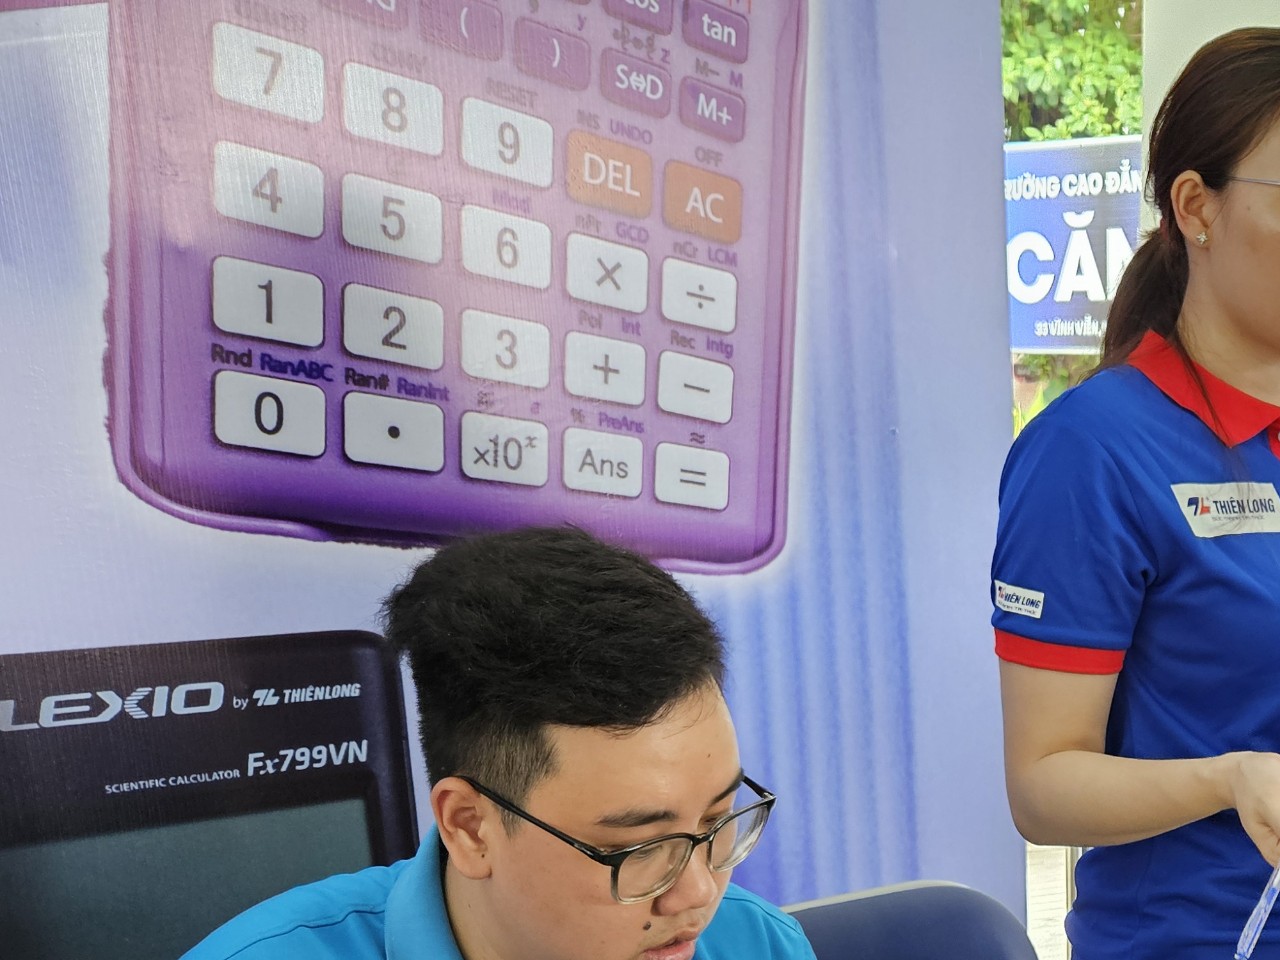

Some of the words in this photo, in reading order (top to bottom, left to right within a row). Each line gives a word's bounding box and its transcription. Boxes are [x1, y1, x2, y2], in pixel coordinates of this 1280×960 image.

[701, 13, 738, 47] tan
[255, 47, 283, 95] 7
[381, 86, 408, 133] 8
[696, 93, 733, 126] M+
[498, 121, 520, 165] 9
[609, 118, 654, 145] UNDO
[583, 151, 641, 197] DEL
[695, 146, 724, 168] OFF
[252, 167, 283, 214] 4
[1062, 171, 1103, 197] CAO
[380, 194, 406, 241] 5
[685, 186, 725, 224] AC
[497, 227, 519, 269] 6
[616, 221, 650, 244] GCD
[707, 246, 739, 268] LCM
[257, 279, 274, 325] 1
[381, 306, 408, 351] 2
[670, 329, 697, 351] Rec
[211, 343, 253, 369] Rnd
[259, 352, 336, 383] RanABC
[495, 328, 518, 370] 3
[706, 336, 734, 360] Intg
[344, 366, 391, 392] Ran#
[254, 391, 285, 435] 0
[578, 448, 630, 480] Ans
[1213, 497, 1246, 515] THIÊN
[1247, 498, 1276, 515] LONG
[1021, 597, 1041, 609] LONG
[233, 695, 249, 711] by
[105, 777, 167, 794] SCIENTIFIC
[169, 769, 240, 787] CALCULATOR
[247, 739, 368, 777] Fx799VN
